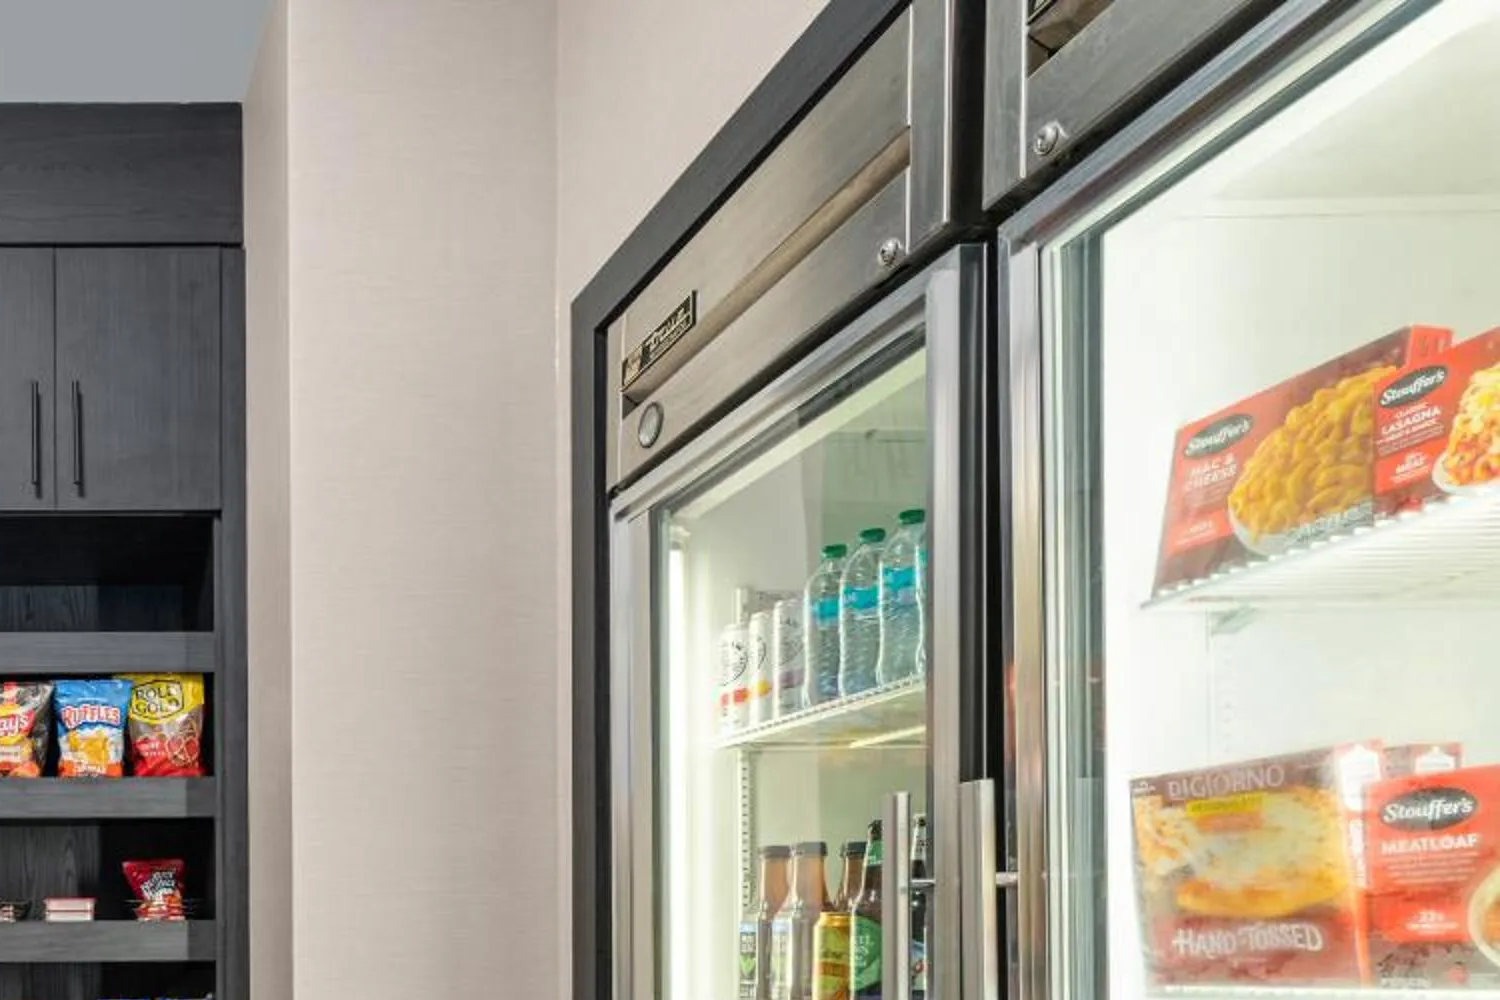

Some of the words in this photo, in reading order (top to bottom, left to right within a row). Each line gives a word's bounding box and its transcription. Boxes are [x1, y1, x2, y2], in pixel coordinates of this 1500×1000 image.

[1381, 369, 1445, 406] Stouffer's
[1383, 798, 1474, 823] Stouffer's
[1381, 833, 1477, 855] MEATLOAF
